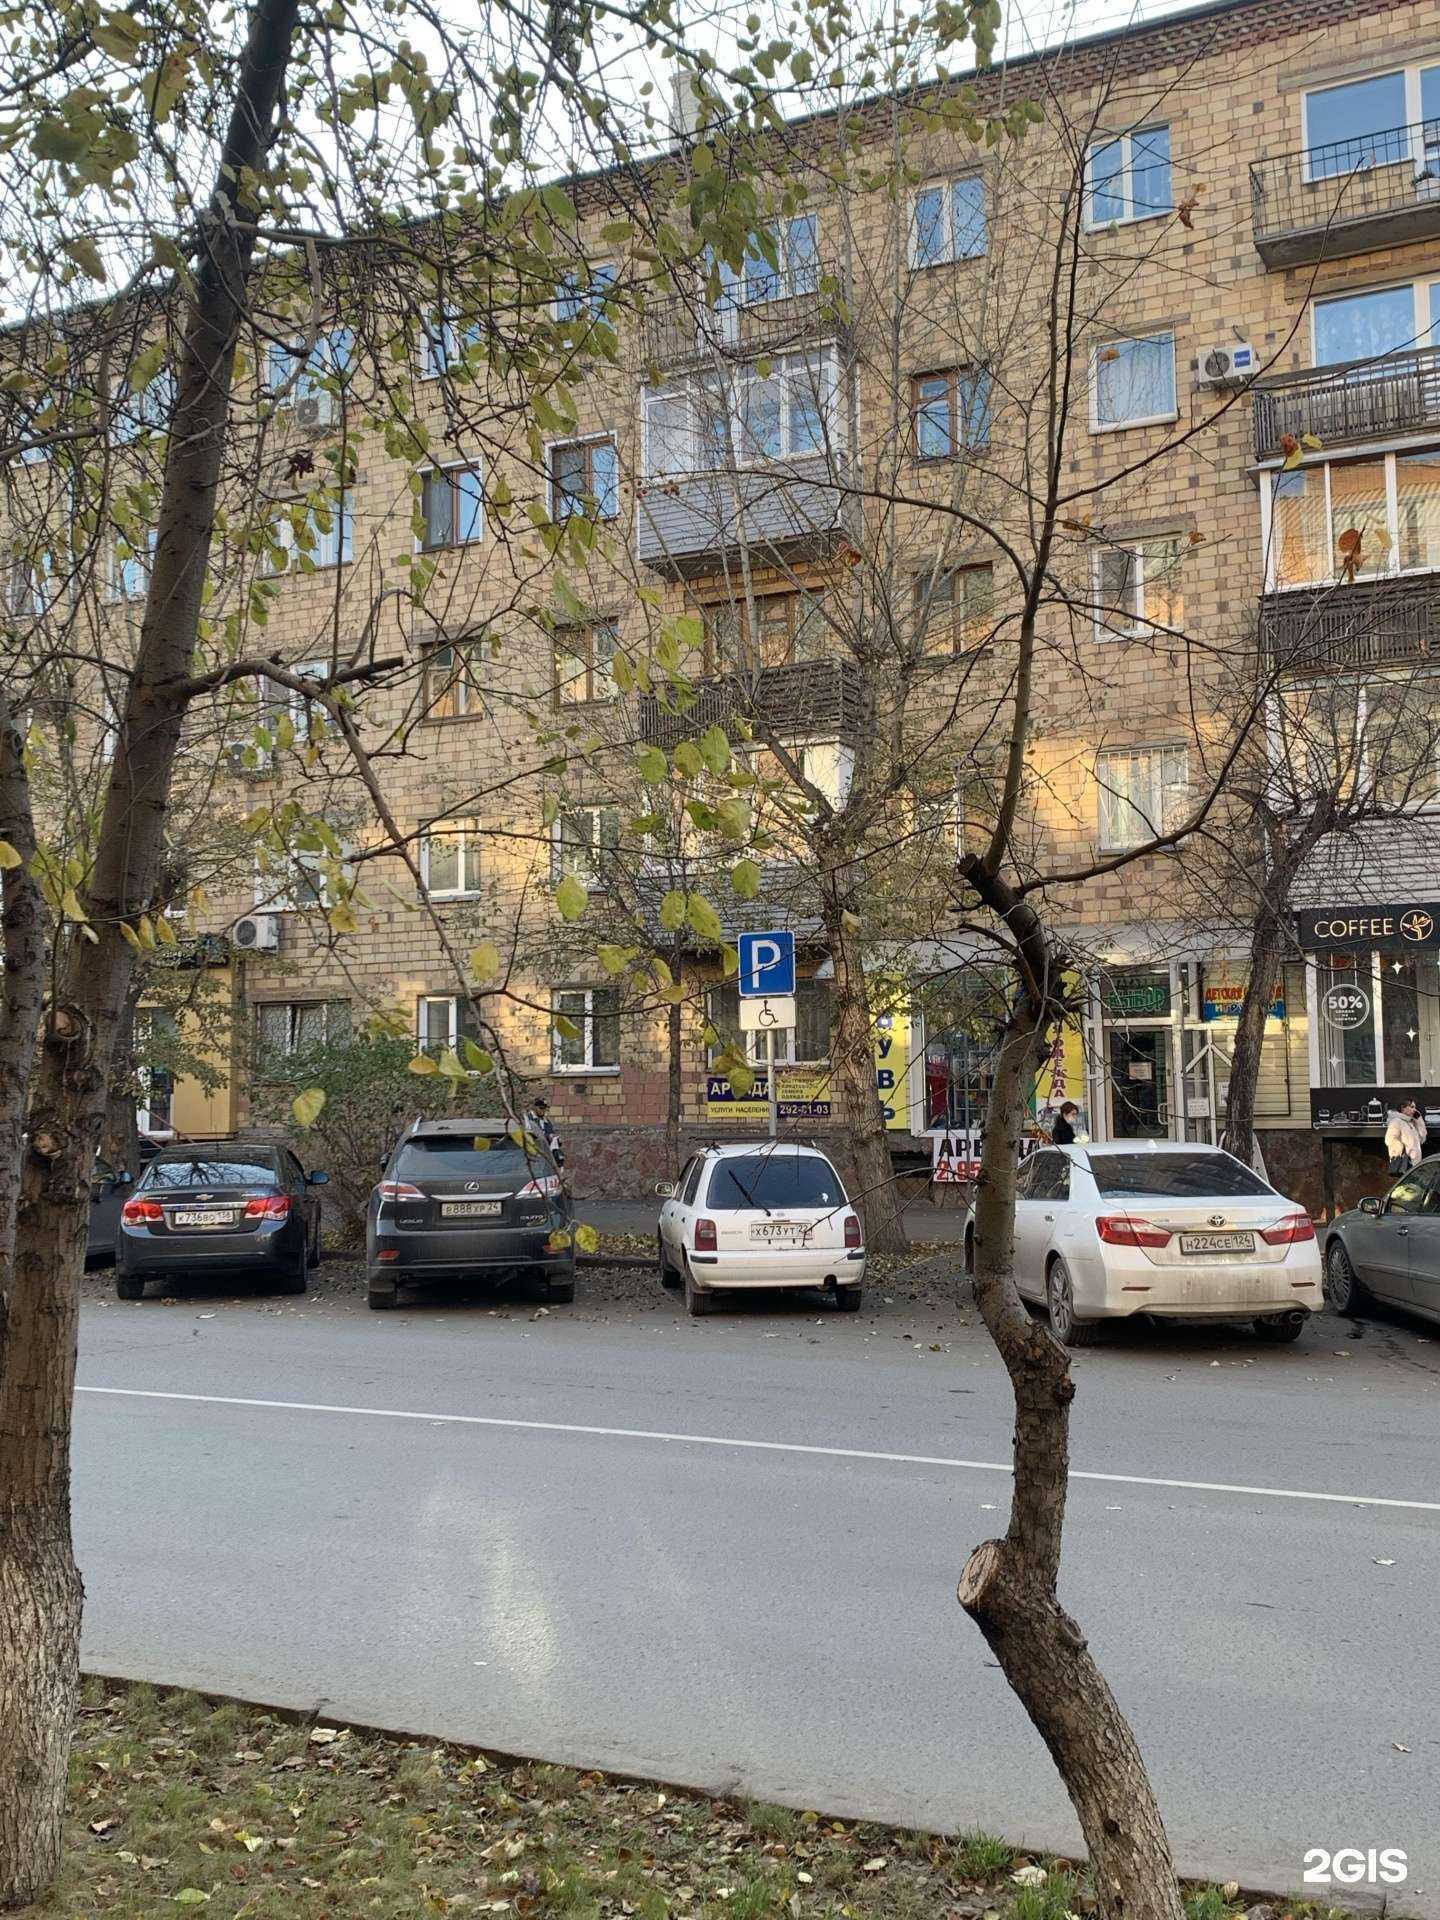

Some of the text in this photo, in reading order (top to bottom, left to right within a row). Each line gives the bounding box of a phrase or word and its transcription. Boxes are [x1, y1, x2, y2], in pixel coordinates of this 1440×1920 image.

[1314, 918, 1394, 938] COFFEE
[751, 940, 780, 988] P
[1328, 995, 1363, 1010] 50%
[755, 1225, 795, 1236] Х673УТ
[1186, 1235, 1252, 1250] Н224СЕ 124
